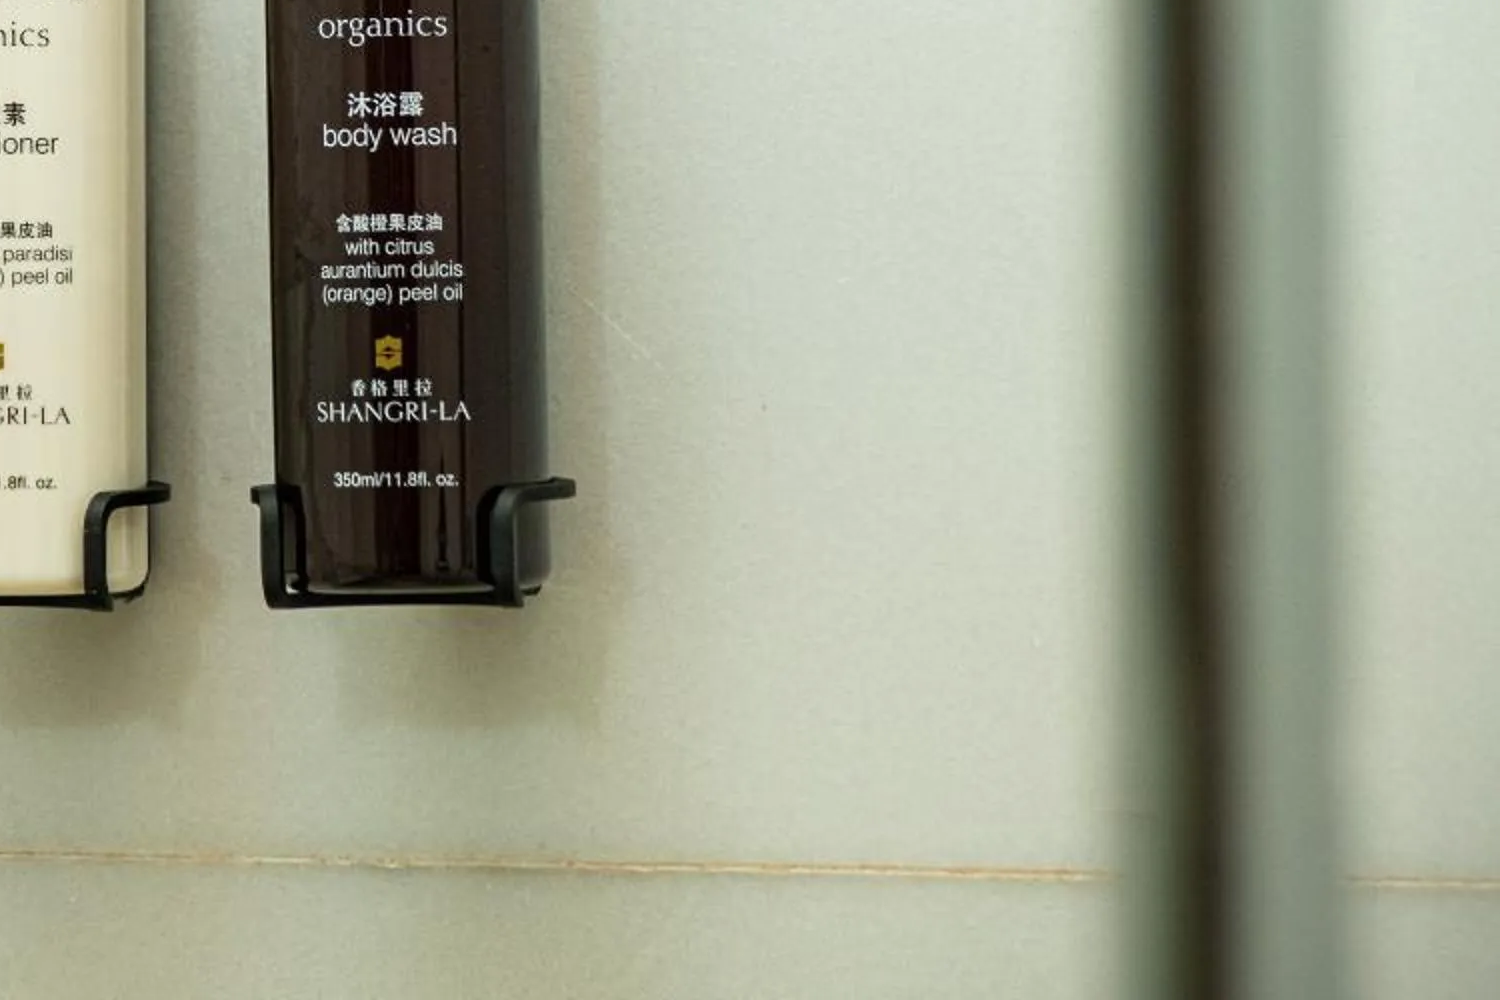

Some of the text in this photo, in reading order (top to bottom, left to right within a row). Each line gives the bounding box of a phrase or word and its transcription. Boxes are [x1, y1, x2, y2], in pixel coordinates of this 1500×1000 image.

[318, 9, 448, 47] organics
[347, 91, 424, 118] 沐浴露
[322, 122, 457, 152] body wash
[3, 246, 73, 265] paradisi
[345, 238, 435, 256] with citrus
[11, 268, 49, 288] peel
[55, 268, 73, 284] oil
[320, 260, 463, 280] aurantium dulcis
[322, 283, 463, 307] (orange) peel oil
[351, 379, 433, 397] 香格里拉
[317, 401, 471, 423] SHANGRI-LA
